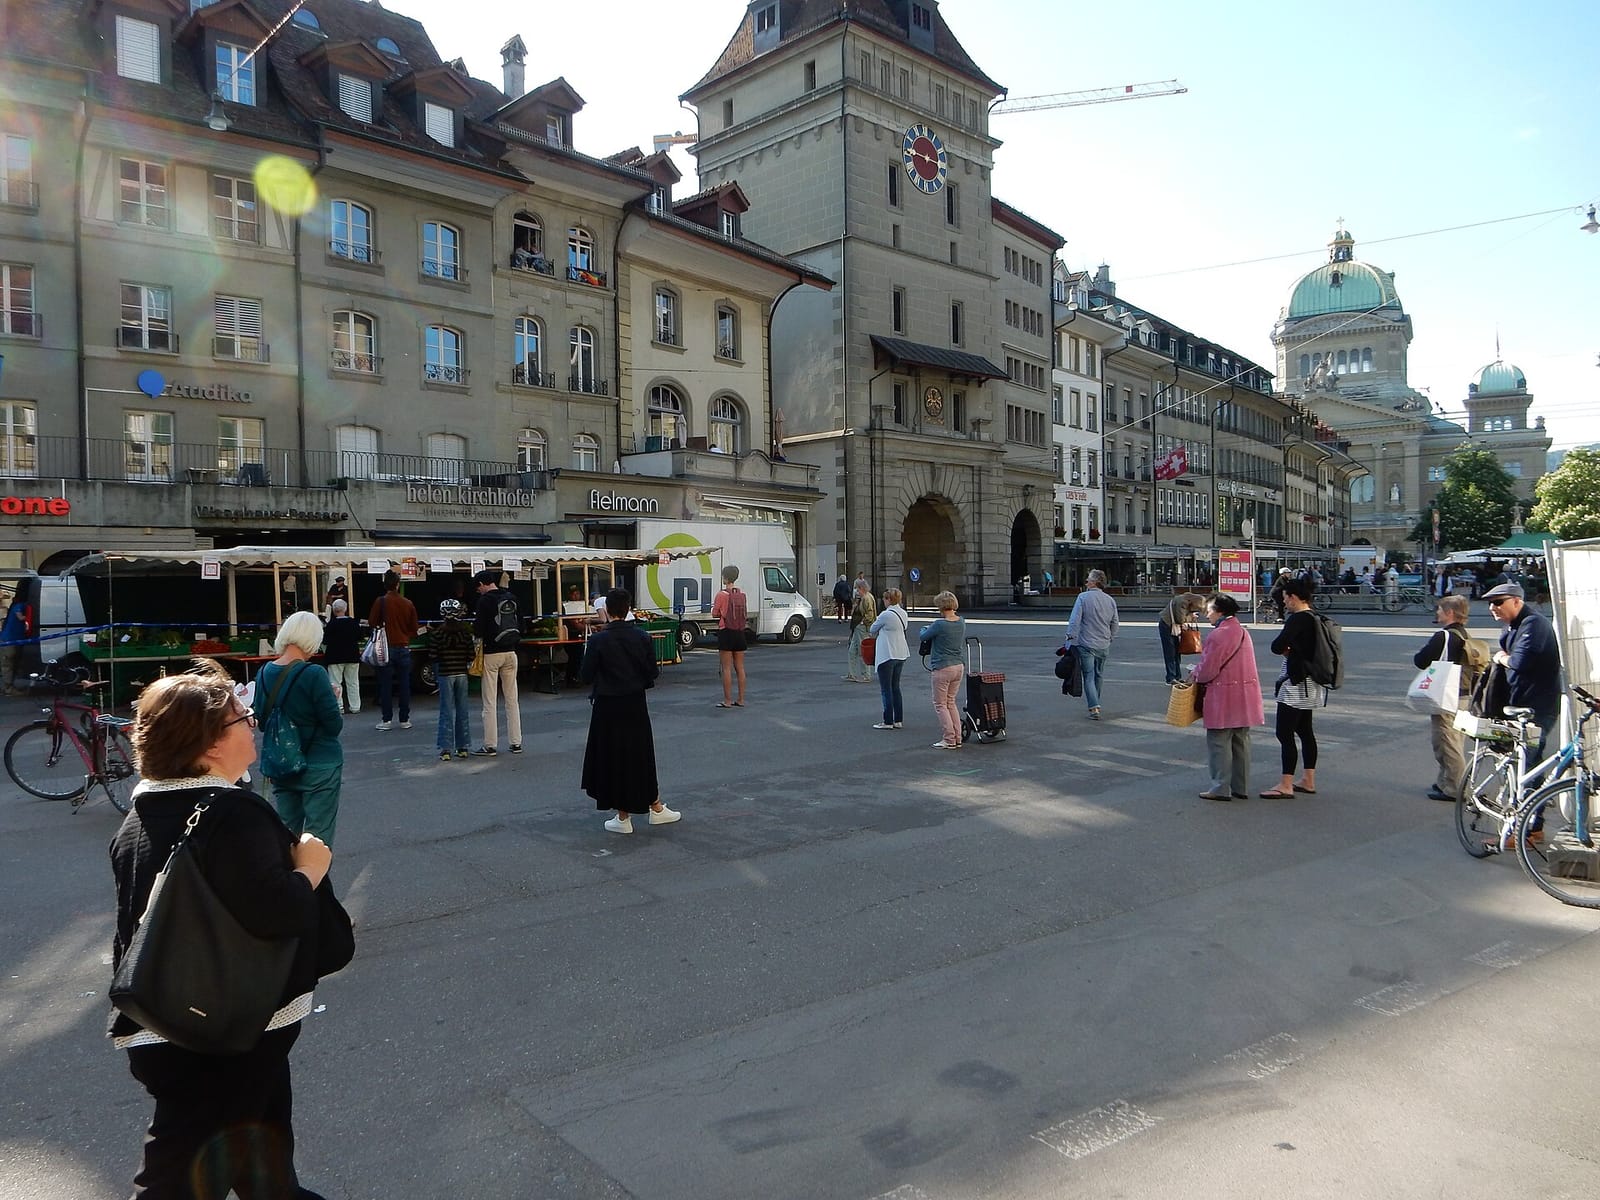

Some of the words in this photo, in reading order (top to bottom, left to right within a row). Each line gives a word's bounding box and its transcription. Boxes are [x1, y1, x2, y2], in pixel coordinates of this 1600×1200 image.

[170, 381, 255, 403] Audika
[407, 481, 452, 504] helen
[458, 485, 536, 508] kirchhofer
[0, 496, 71, 516] one
